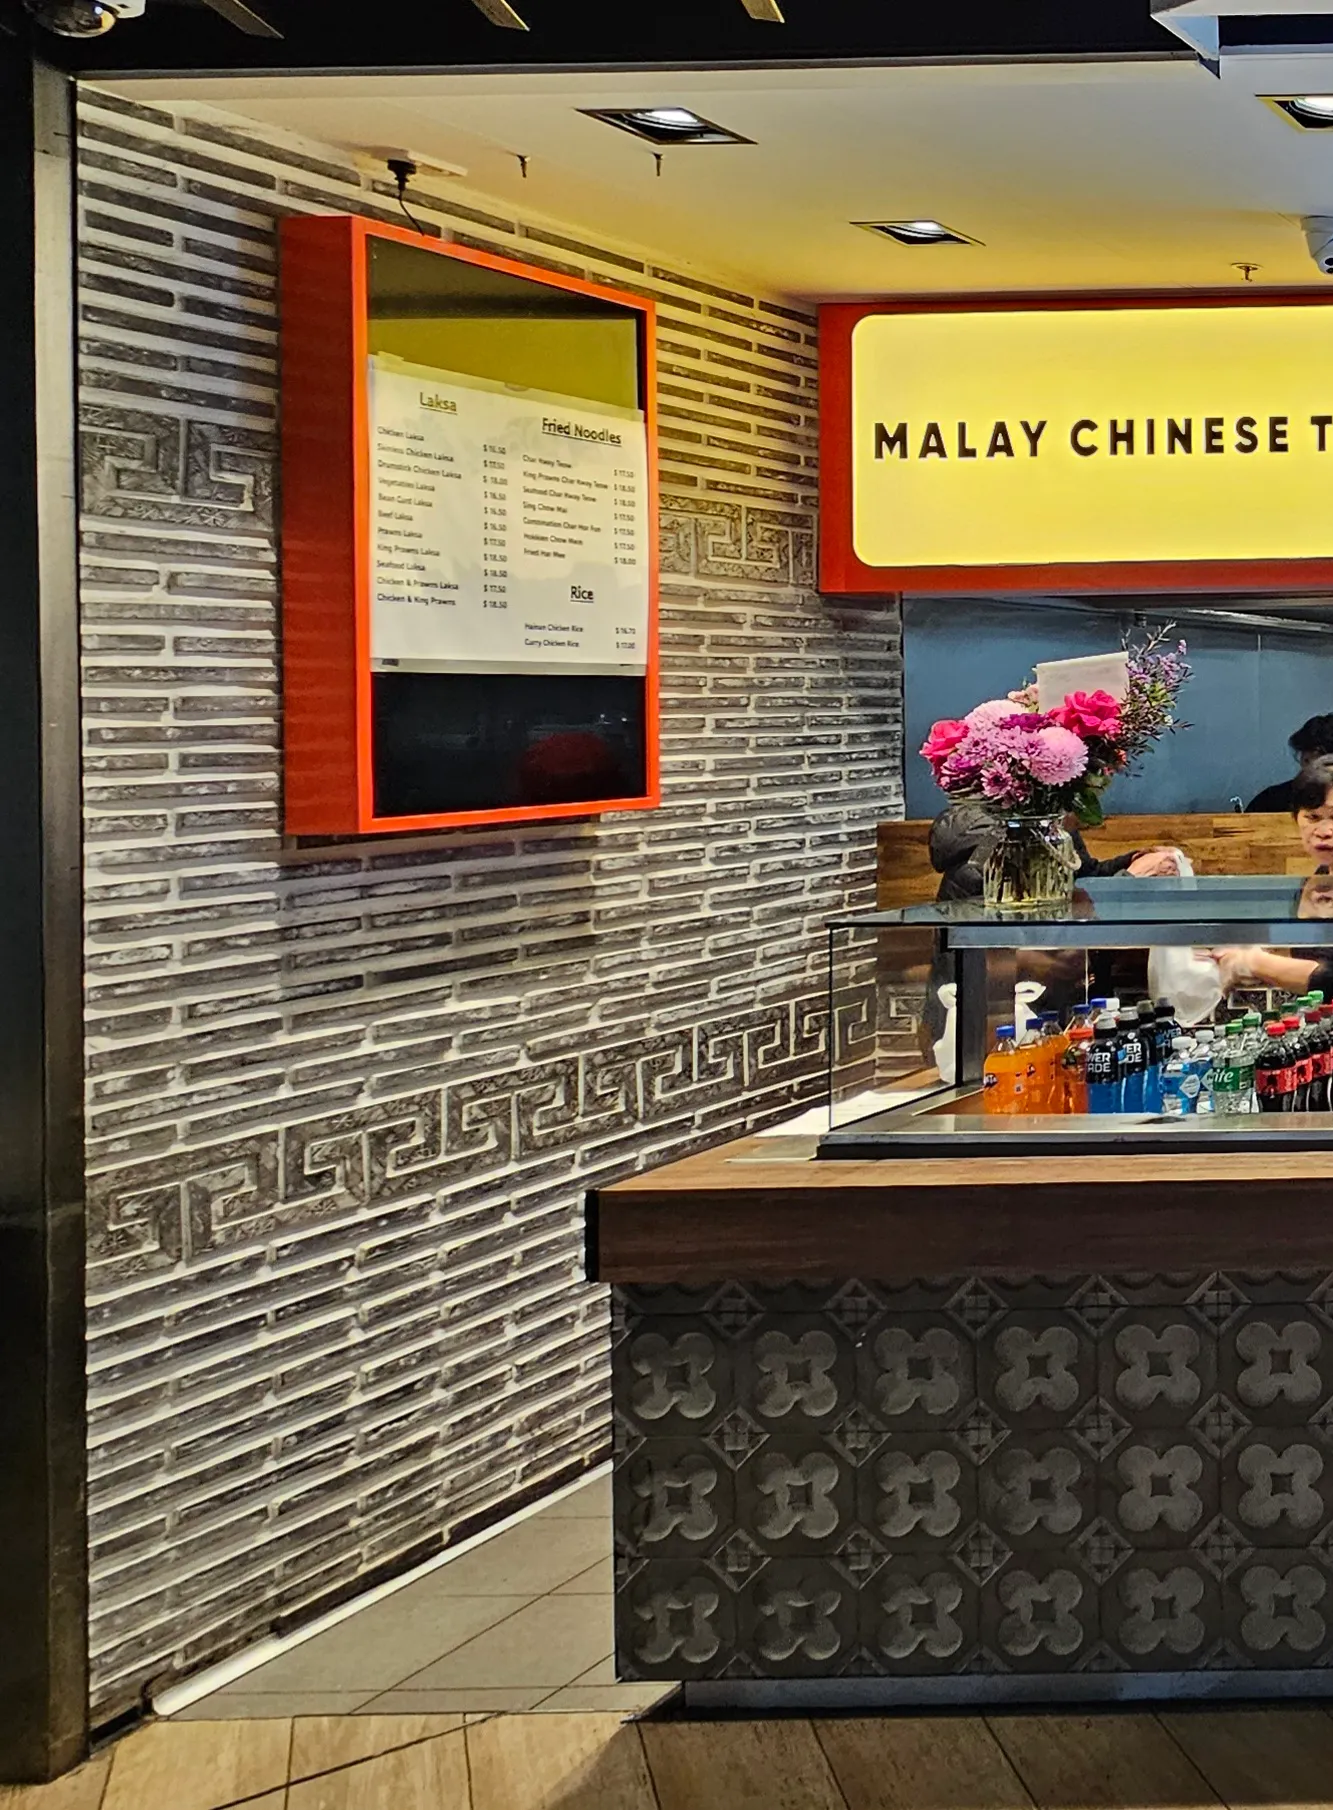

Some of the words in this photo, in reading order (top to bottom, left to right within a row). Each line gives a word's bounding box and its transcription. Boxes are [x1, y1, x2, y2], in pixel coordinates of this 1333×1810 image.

[419, 391, 457, 412] Laksa
[541, 417, 571, 435] Fried
[574, 424, 622, 444] Noodles
[874, 420, 1047, 459] MALAY
[1070, 417, 1289, 455] CHINESE
[570, 585, 594, 601] Rice
